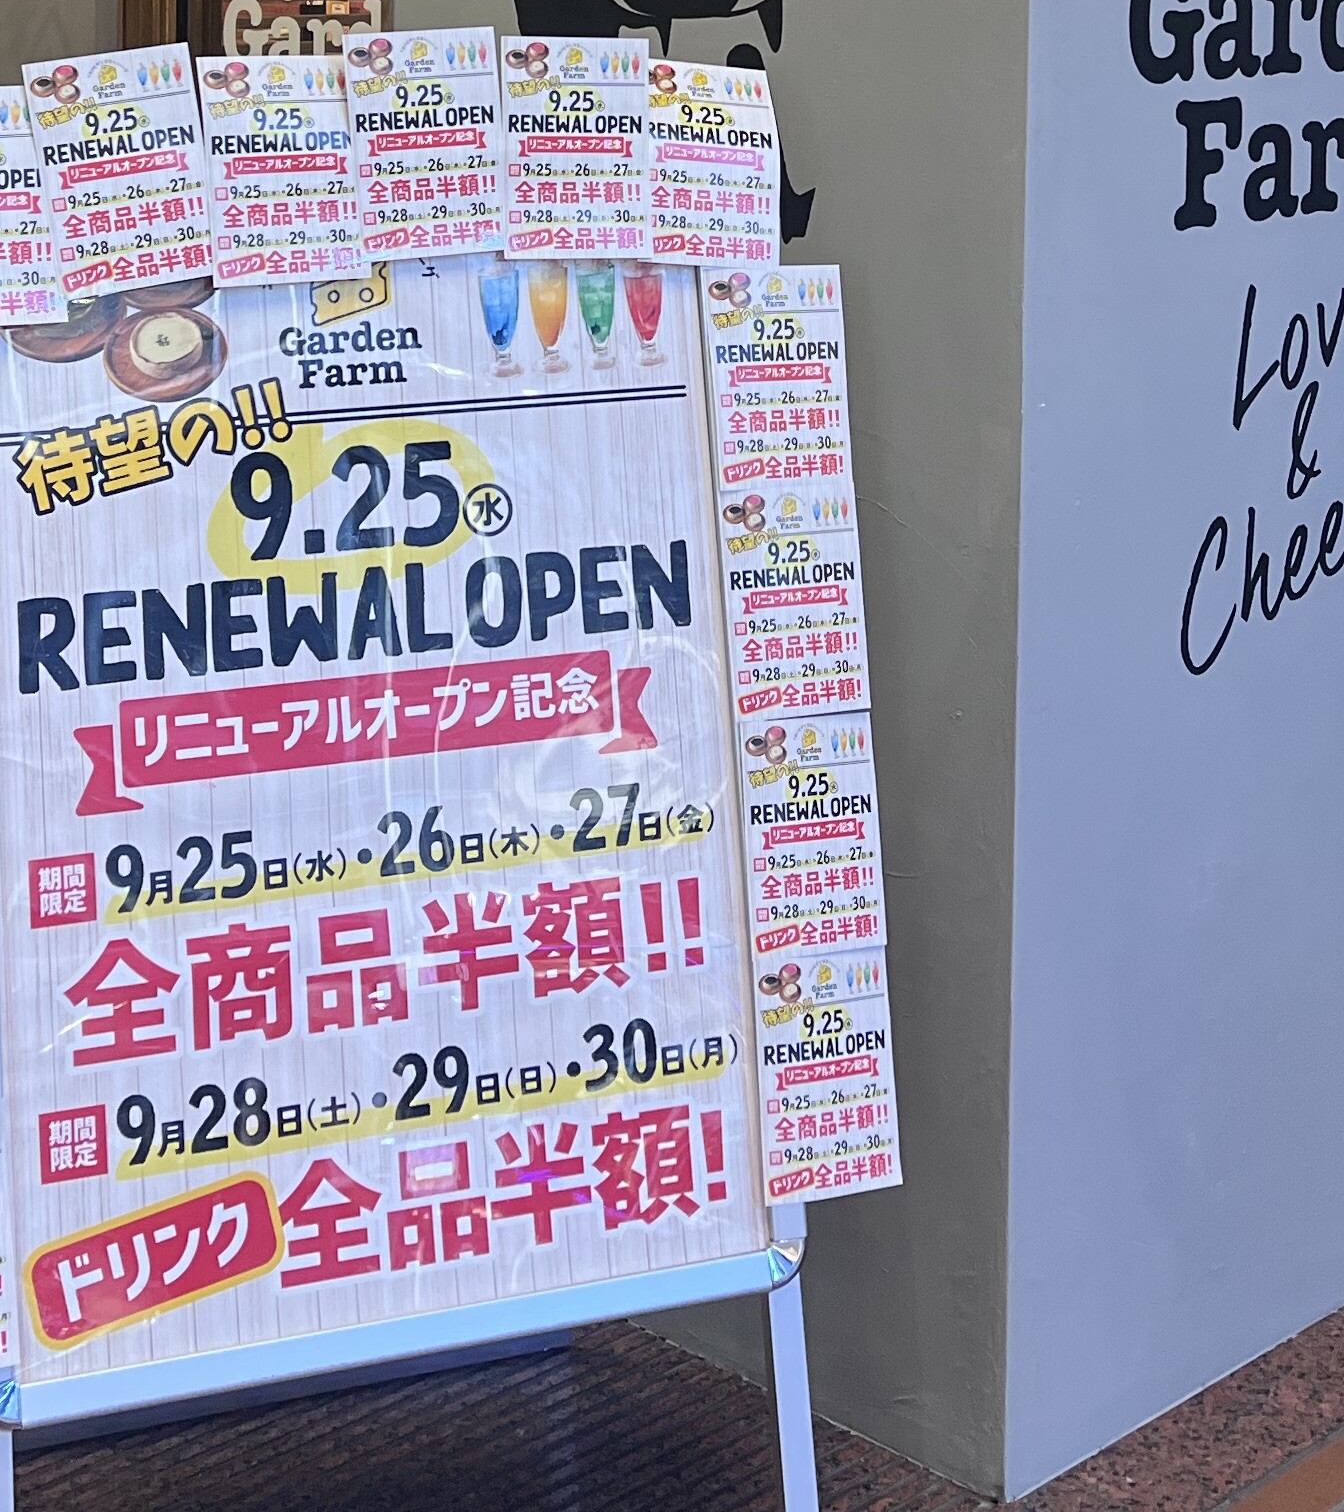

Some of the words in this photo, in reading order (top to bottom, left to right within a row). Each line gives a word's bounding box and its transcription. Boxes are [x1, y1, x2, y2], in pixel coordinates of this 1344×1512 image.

[396, 84, 443, 108] 9.25
[549, 90, 594, 112] 9.25
[86, 108, 137, 136] 9.25
[253, 108, 303, 130] 9.25
[356, 110, 443, 133] RENEWAL
[446, 106, 494, 127] OPEN
[509, 115, 592, 134] RENEWAL
[595, 115, 642, 134] OPEN
[681, 104, 725, 126] 9.25
[43, 138, 139, 166] RENEWAL
[142, 124, 195, 151] OPEN
[212, 133, 302, 155] RENEWAL
[378, 132, 475, 148] リニューアルオープン記念
[528, 139, 622, 150] リニューアルオープン記念
[728, 130, 772, 149] OPEN
[70, 155, 176, 180] リニューアルオープン記念
[234, 157, 336, 171] リニューアルオープン記念
[666, 147, 754, 163] リニューアルオープン記念
[367, 174, 496, 204] 全商品半額!!
[515, 181, 641, 204] 全商品半額!!
[651, 186, 771, 215] 全商品半額!!
[63, 197, 204, 239] 全商品半額!!
[223, 200, 356, 228] 全商品半額!!
[367, 232, 405, 251] ドリンク
[511, 232, 550, 249] ドリンク
[554, 227, 643, 250] 全品半額!
[655, 237, 682, 251] リンク
[686, 234, 771, 262] 全品半額!
[67, 267, 107, 289] ドリンク
[222, 257, 261, 277] ドリンク
[278, 322, 423, 358] Garden
[753, 318, 795, 341] 9.25
[716, 345, 794, 364] RENEWAL
[797, 341, 839, 361] OPEN
[298, 357, 408, 389] Farm
[738, 367, 822, 379] リニューアルオープン記念
[727, 408, 840, 434] 全商品半額!!
[14, 377, 292, 514] 待望の!!
[1287, 381, 1321, 500] &
[727, 463, 762, 481] ドリンク
[765, 454, 844, 479] 全品半額!
[230, 440, 460, 564] 9.25
[767, 540, 810, 565] 9.25
[730, 566, 810, 591] RENEWAL
[813, 562, 855, 584] OPEN
[752, 589, 837, 606] リニューアルオープン記念
[17, 560, 454, 695] RENEWAL
[465, 540, 693, 647] OPEN
[742, 632, 858, 664] 全商品半額!!
[742, 691, 778, 712] ドリンク
[783, 678, 862, 708] 全品半額!
[132, 667, 599, 766] リニューアルオープン記念
[788, 772, 829, 799] 9.25
[750, 799, 830, 826] RENEWAL
[831, 794, 872, 818] OPEN
[772, 821, 856, 841] リニューアルオープン記念
[37, 863, 87, 891] 期間
[761, 867, 874, 900] 全商品半額!!
[39, 888, 89, 915] 限定
[759, 929, 796, 951] ドリンク
[801, 915, 878, 946] 全品半額!
[63, 876, 705, 1068] 全商品半額!!
[803, 1010, 843, 1038] 9.25
[764, 1037, 842, 1067] RENEWAL
[846, 1029, 885, 1054] OPEN
[786, 1058, 870, 1081] リニューアルオープン記念
[48, 1116, 97, 1143] 期間
[775, 1104, 889, 1143] 全商品半額!!
[49, 1140, 99, 1168] 限定
[772, 1172, 811, 1194] ドリンク
[815, 1153, 893, 1190] 全品半額!
[57, 1197, 251, 1322] ドリンク
[280, 1109, 727, 1289] 全品半額!
